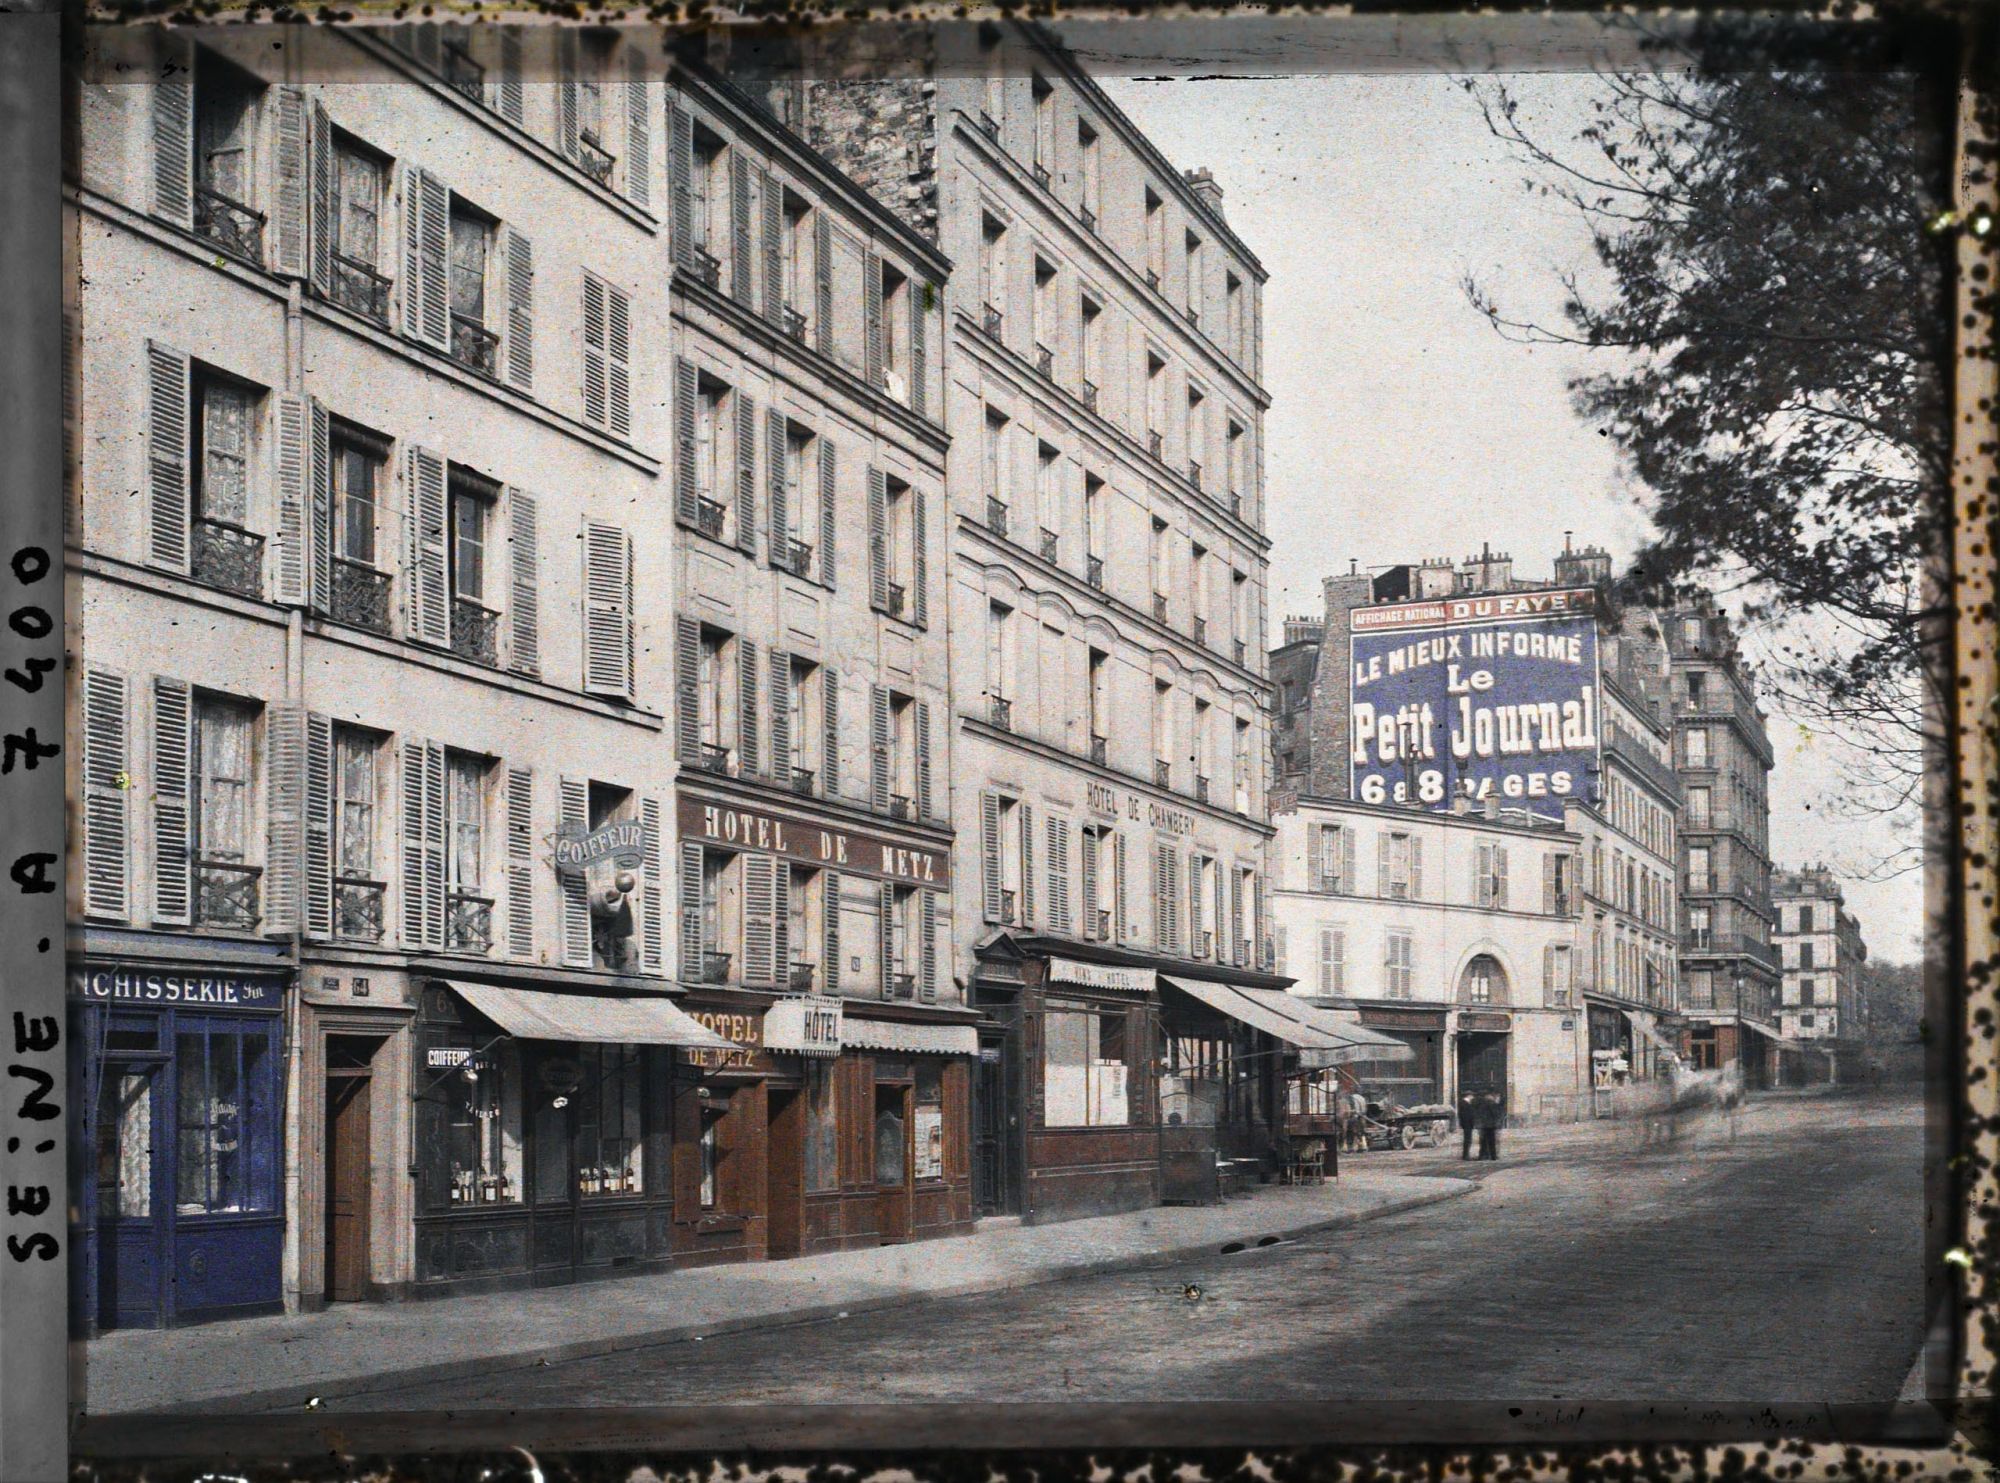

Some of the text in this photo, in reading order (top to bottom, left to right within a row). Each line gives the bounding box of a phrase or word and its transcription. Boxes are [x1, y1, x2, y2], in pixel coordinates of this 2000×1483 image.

[1354, 593, 1584, 625] AFFICHAGE NATIONAL DUFAYE
[1356, 631, 1582, 687] LE MIEUX INFORMÉ
[1447, 664, 1496, 693] Le
[1353, 685, 1596, 765] Petit Journal
[1361, 774, 1386, 804] 6
[1419, 769, 1445, 804] 8
[1128, 796, 1140, 822] DE
[556, 825, 641, 865] COIFFEUR
[703, 805, 934, 882] HOTEL DE METZ
[9, 852, 58, 895] A
[688, 1046, 709, 1067] DE
